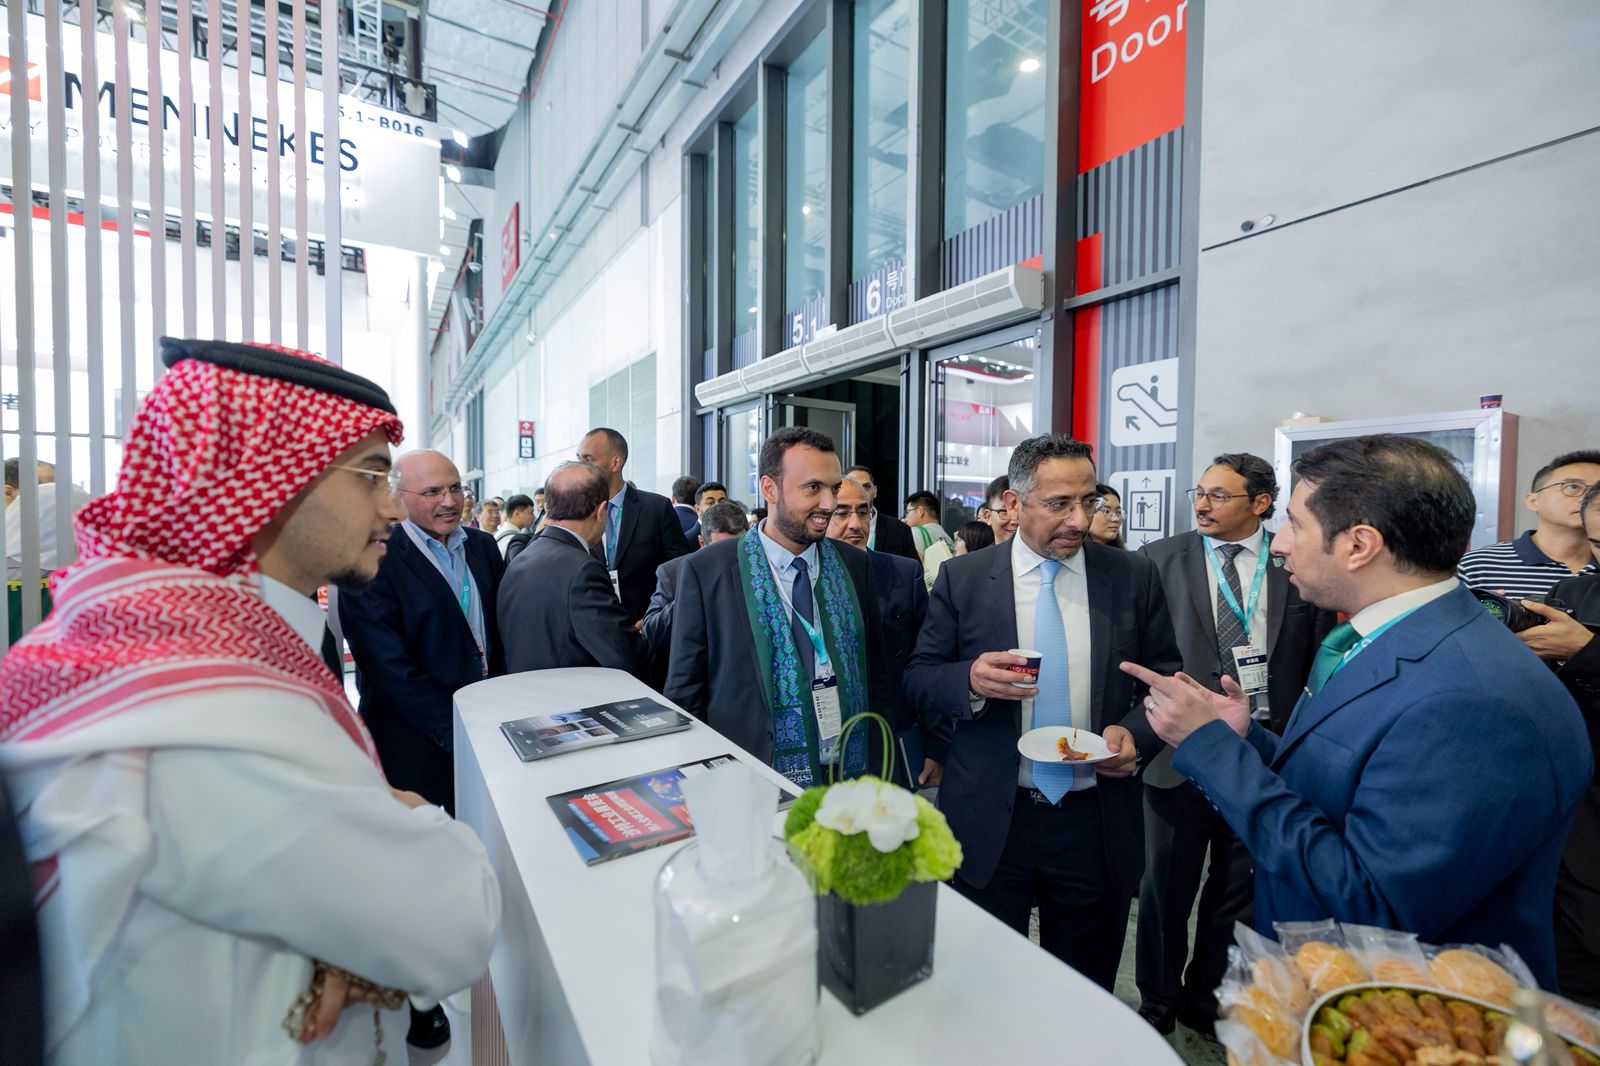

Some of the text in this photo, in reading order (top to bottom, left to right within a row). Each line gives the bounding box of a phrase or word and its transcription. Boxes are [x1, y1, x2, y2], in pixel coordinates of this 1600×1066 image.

[1091, 0, 1188, 84] Door
[866, 279, 881, 315] 6
[885, 294, 906, 309] Doo
